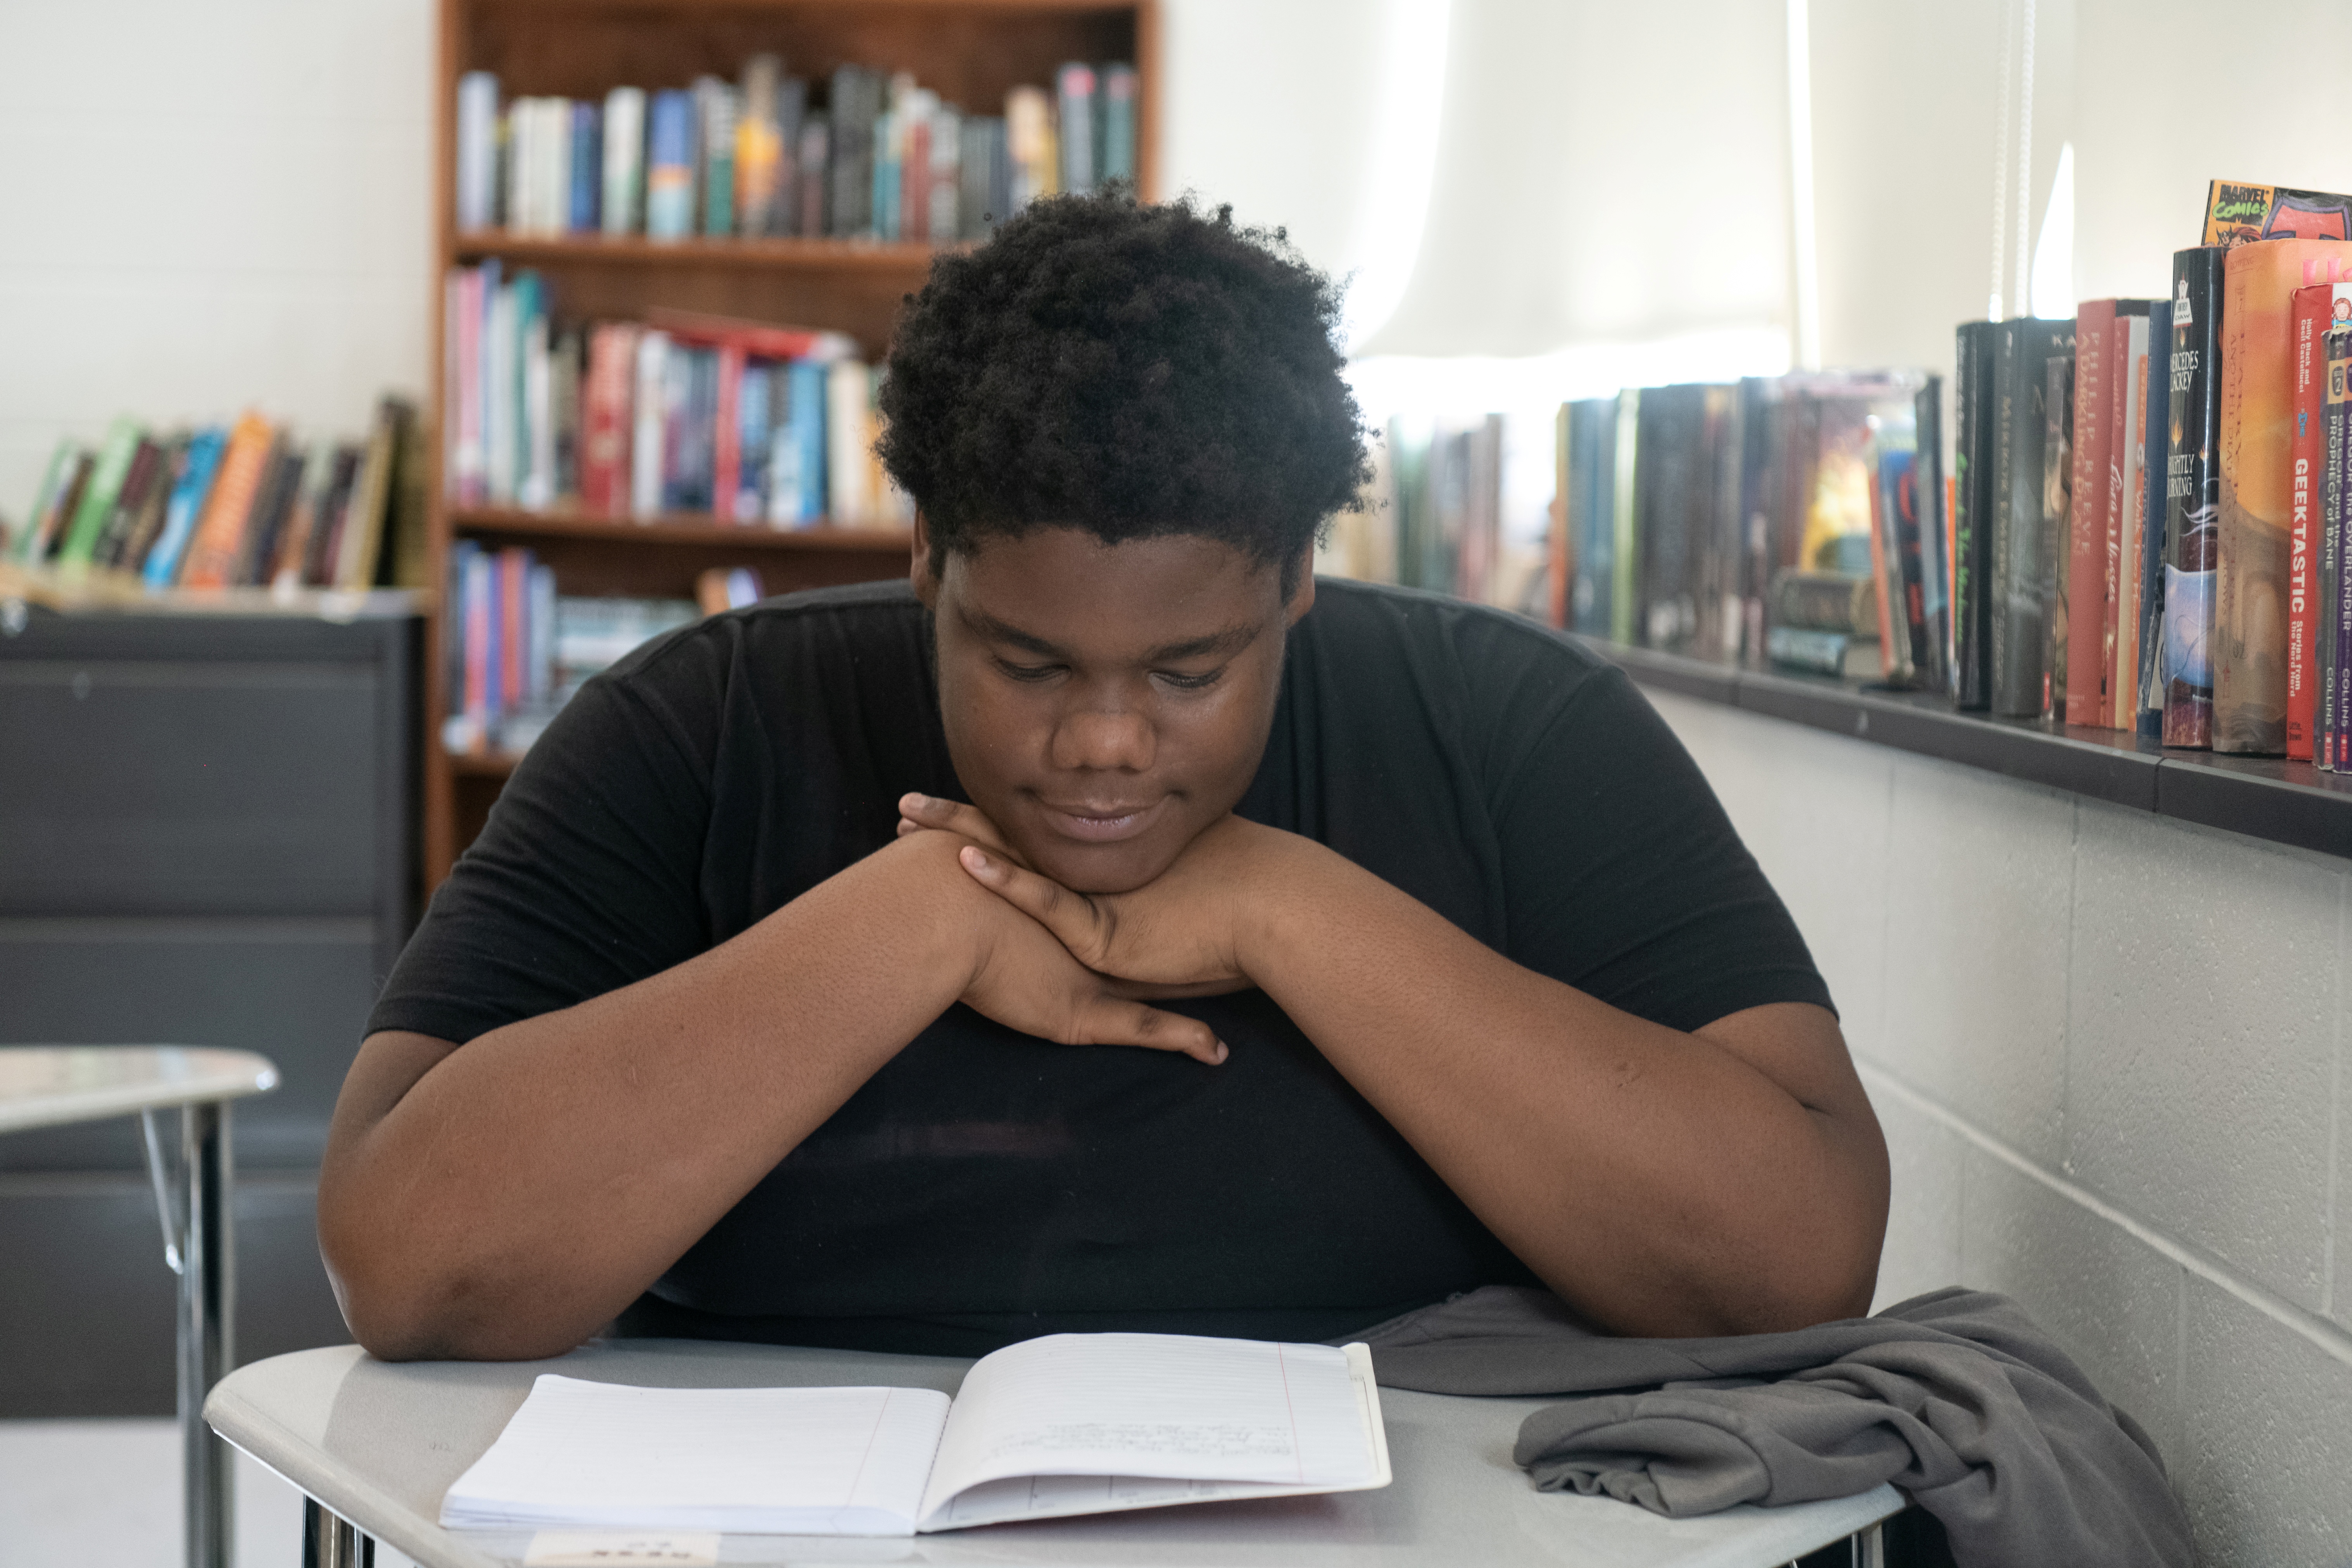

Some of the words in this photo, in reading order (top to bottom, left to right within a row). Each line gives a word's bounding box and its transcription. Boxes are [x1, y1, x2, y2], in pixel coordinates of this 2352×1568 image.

[2081, 333, 2090, 351] A
[2087, 332, 2100, 441] PHILIP
[2335, 377, 2342, 392] 2
[2167, 454, 2195, 475] RIGHTLY
[2327, 415, 2338, 504] PROPHECY
[2336, 414, 2344, 483] GREGOR
[2167, 476, 2192, 498] URNING
[2292, 458, 2309, 613] GEEKTASTIC
[2326, 507, 2335, 522] of
[2325, 527, 2334, 570] BANE
[2343, 521, 2352, 630] OVERLANDER
[2295, 620, 2304, 661] Stories
[2341, 668, 2350, 727] COLLINS
